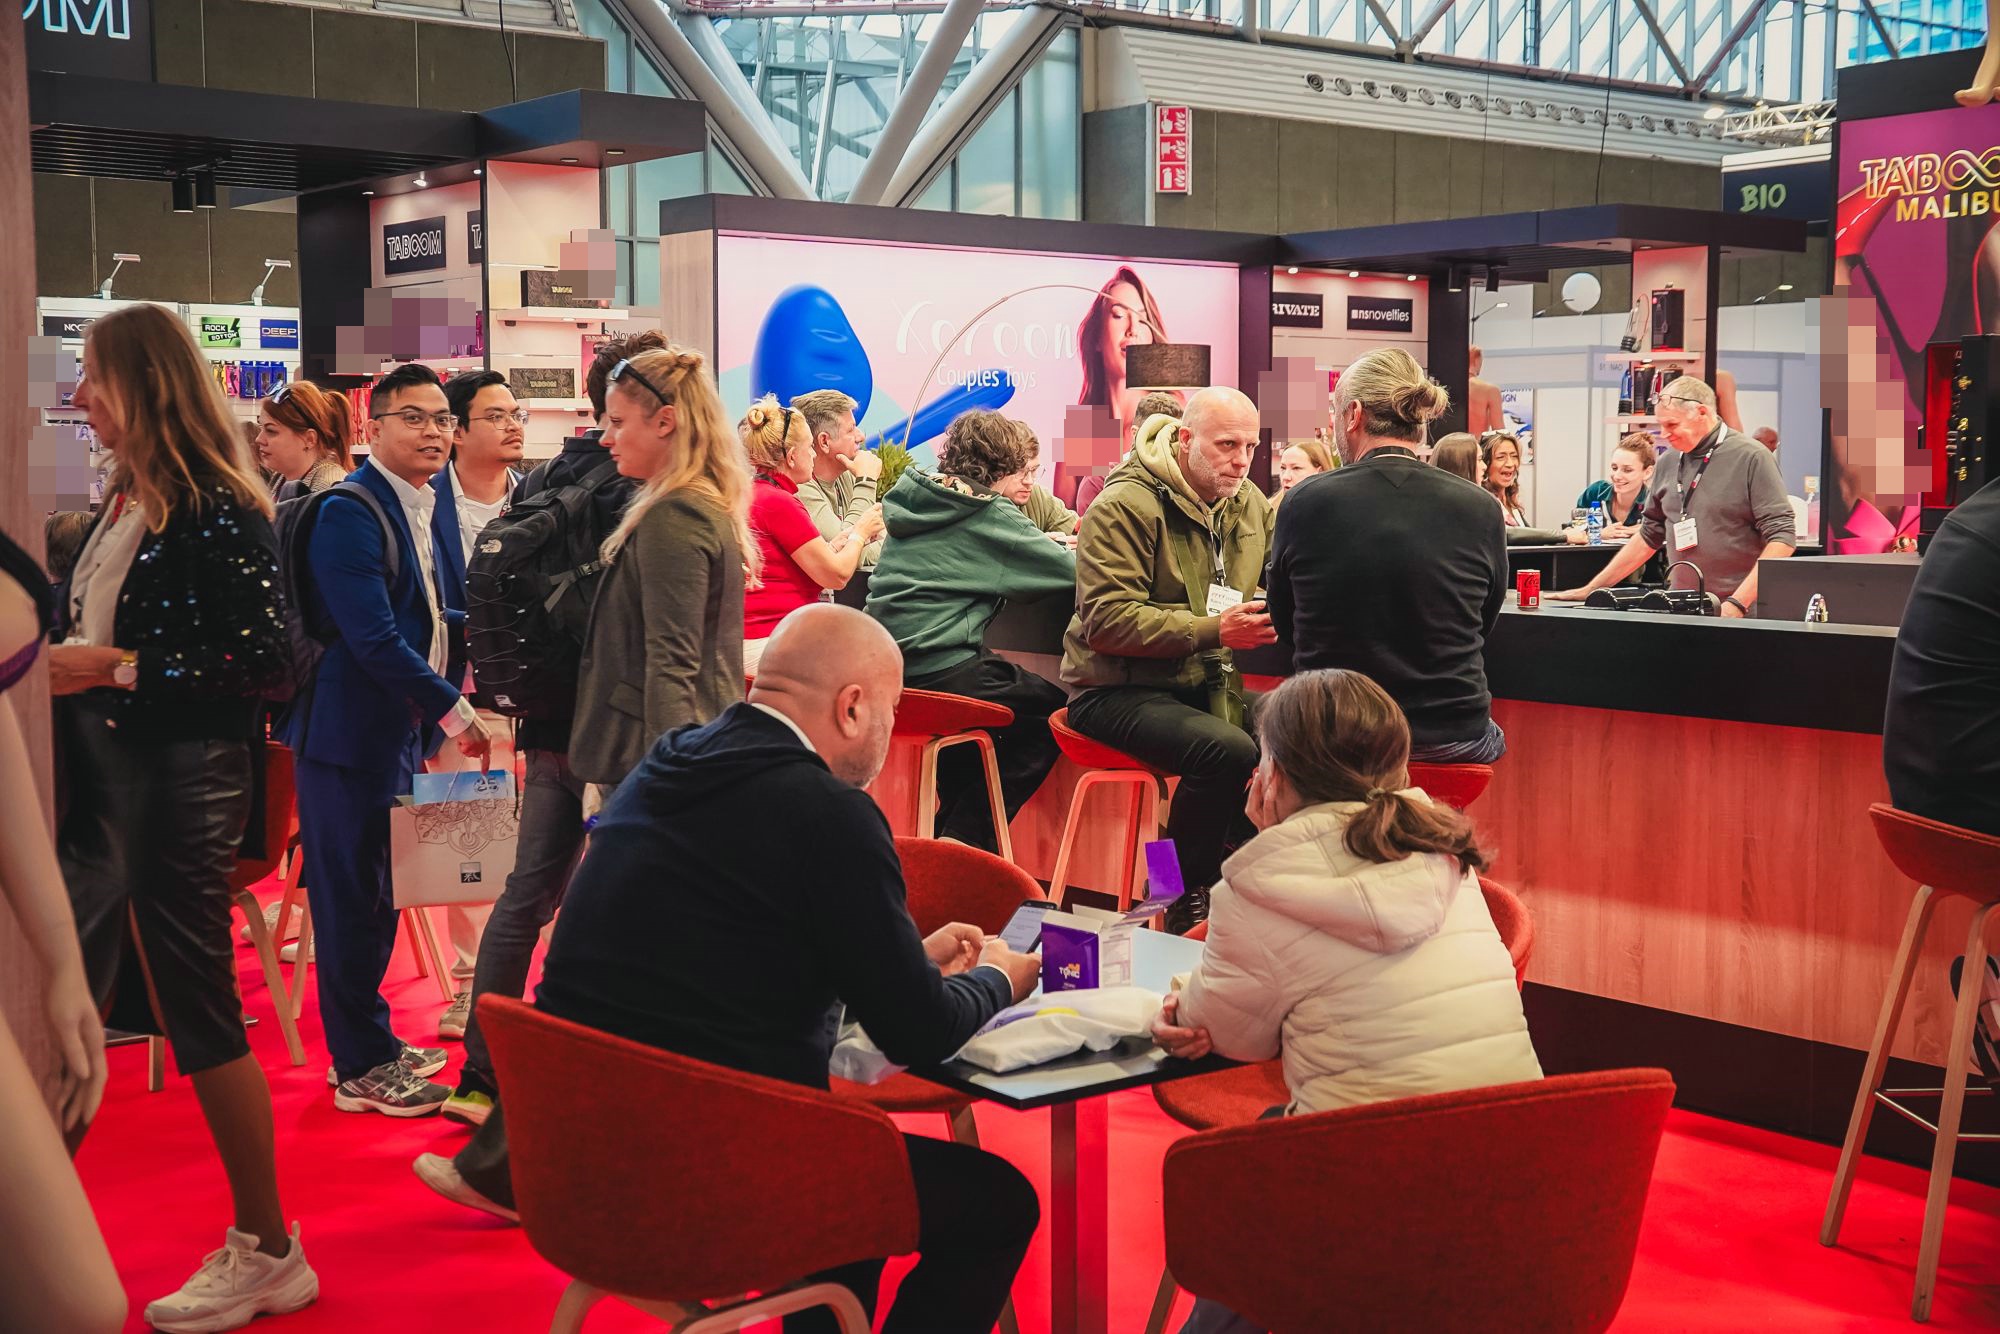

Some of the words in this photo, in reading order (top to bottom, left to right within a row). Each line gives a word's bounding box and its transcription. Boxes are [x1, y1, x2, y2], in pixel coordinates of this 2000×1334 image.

[1739, 183, 1787, 213] BIO
[387, 230, 441, 261] TABOOM
[471, 223, 482, 250] T
[205, 324, 226, 332] ROCK
[211, 331, 237, 341] BOTTOM
[261, 327, 297, 335] DEEP
[936, 364, 1000, 391] Couples
[1005, 365, 1036, 391] Toys
